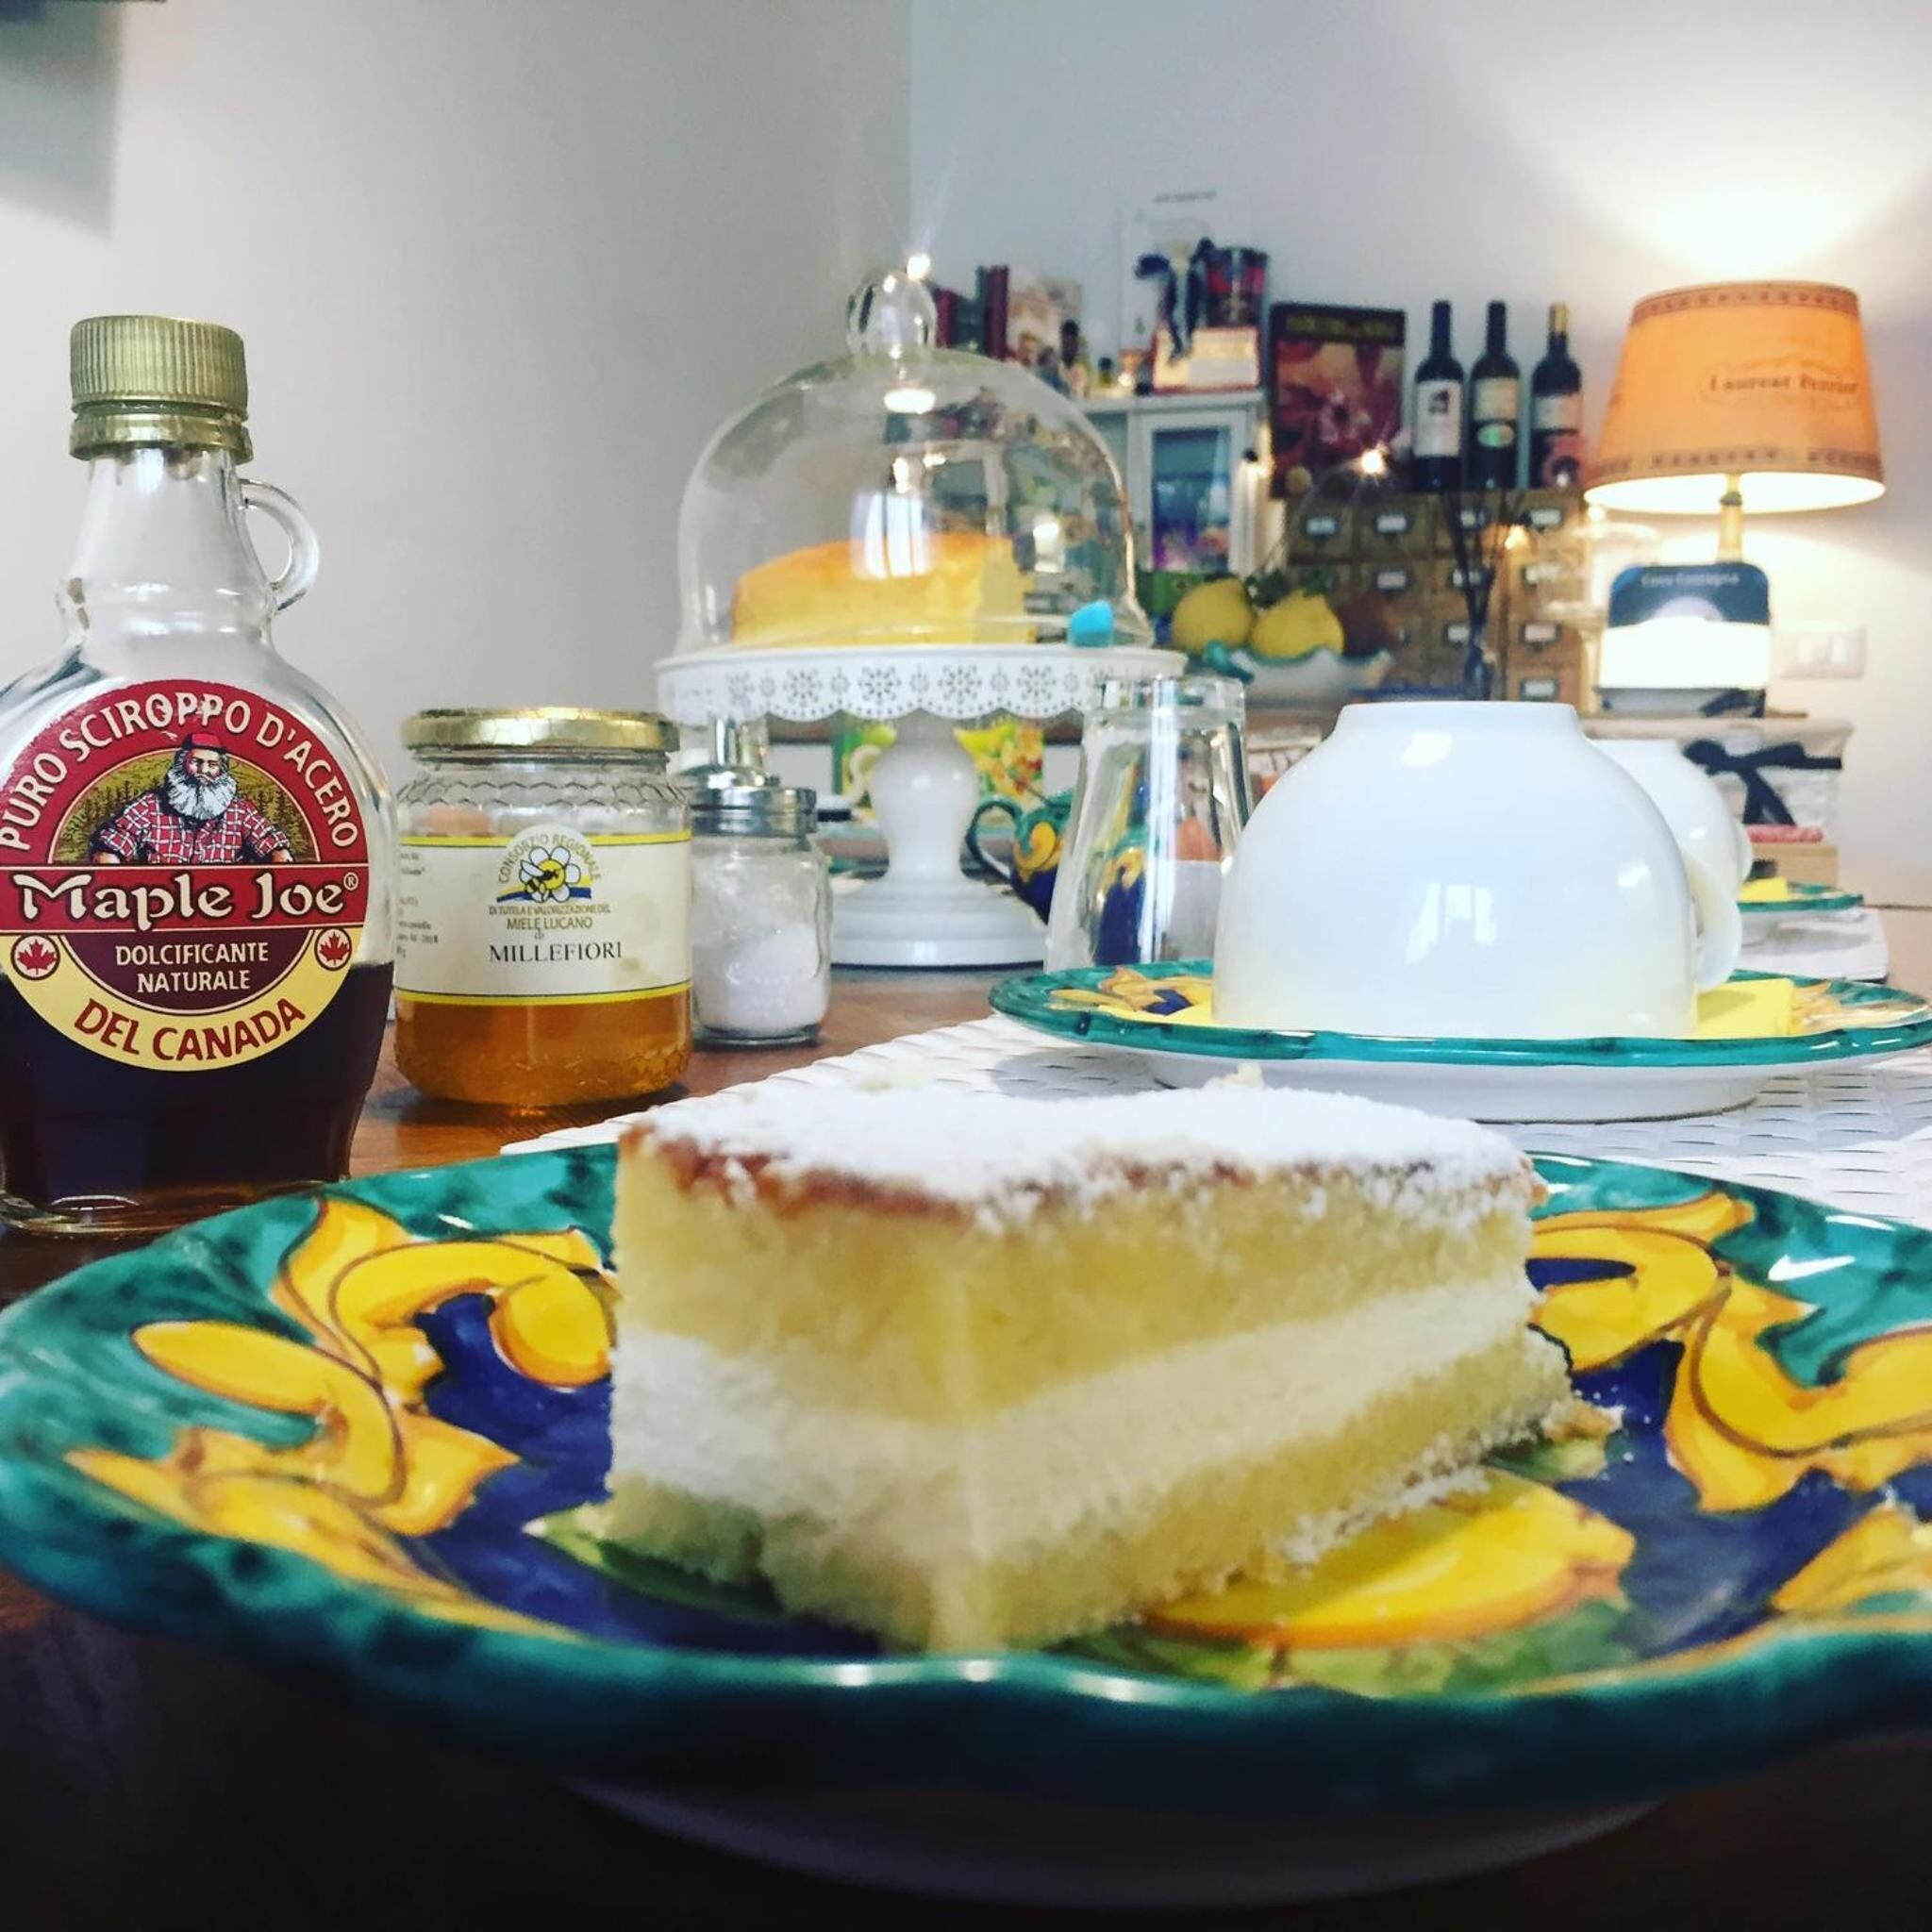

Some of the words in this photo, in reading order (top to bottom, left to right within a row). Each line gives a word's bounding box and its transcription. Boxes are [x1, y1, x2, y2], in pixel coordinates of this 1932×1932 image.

[0, 753, 68, 851] PURO
[59, 691, 251, 762] SCIROPPO
[256, 712, 358, 847] D'ACERO
[497, 834, 548, 884] CONSORZIO
[12, 874, 233, 932] Maple
[507, 918, 541, 930] MIELE
[543, 916, 593, 929] LUCANO
[115, 942, 269, 967] DOLCIFICANTE
[489, 941, 622, 962] MILLEFIORI
[137, 970, 251, 993] NATURALE
[74, 998, 140, 1056] DEL
[152, 998, 307, 1061] CANADA
